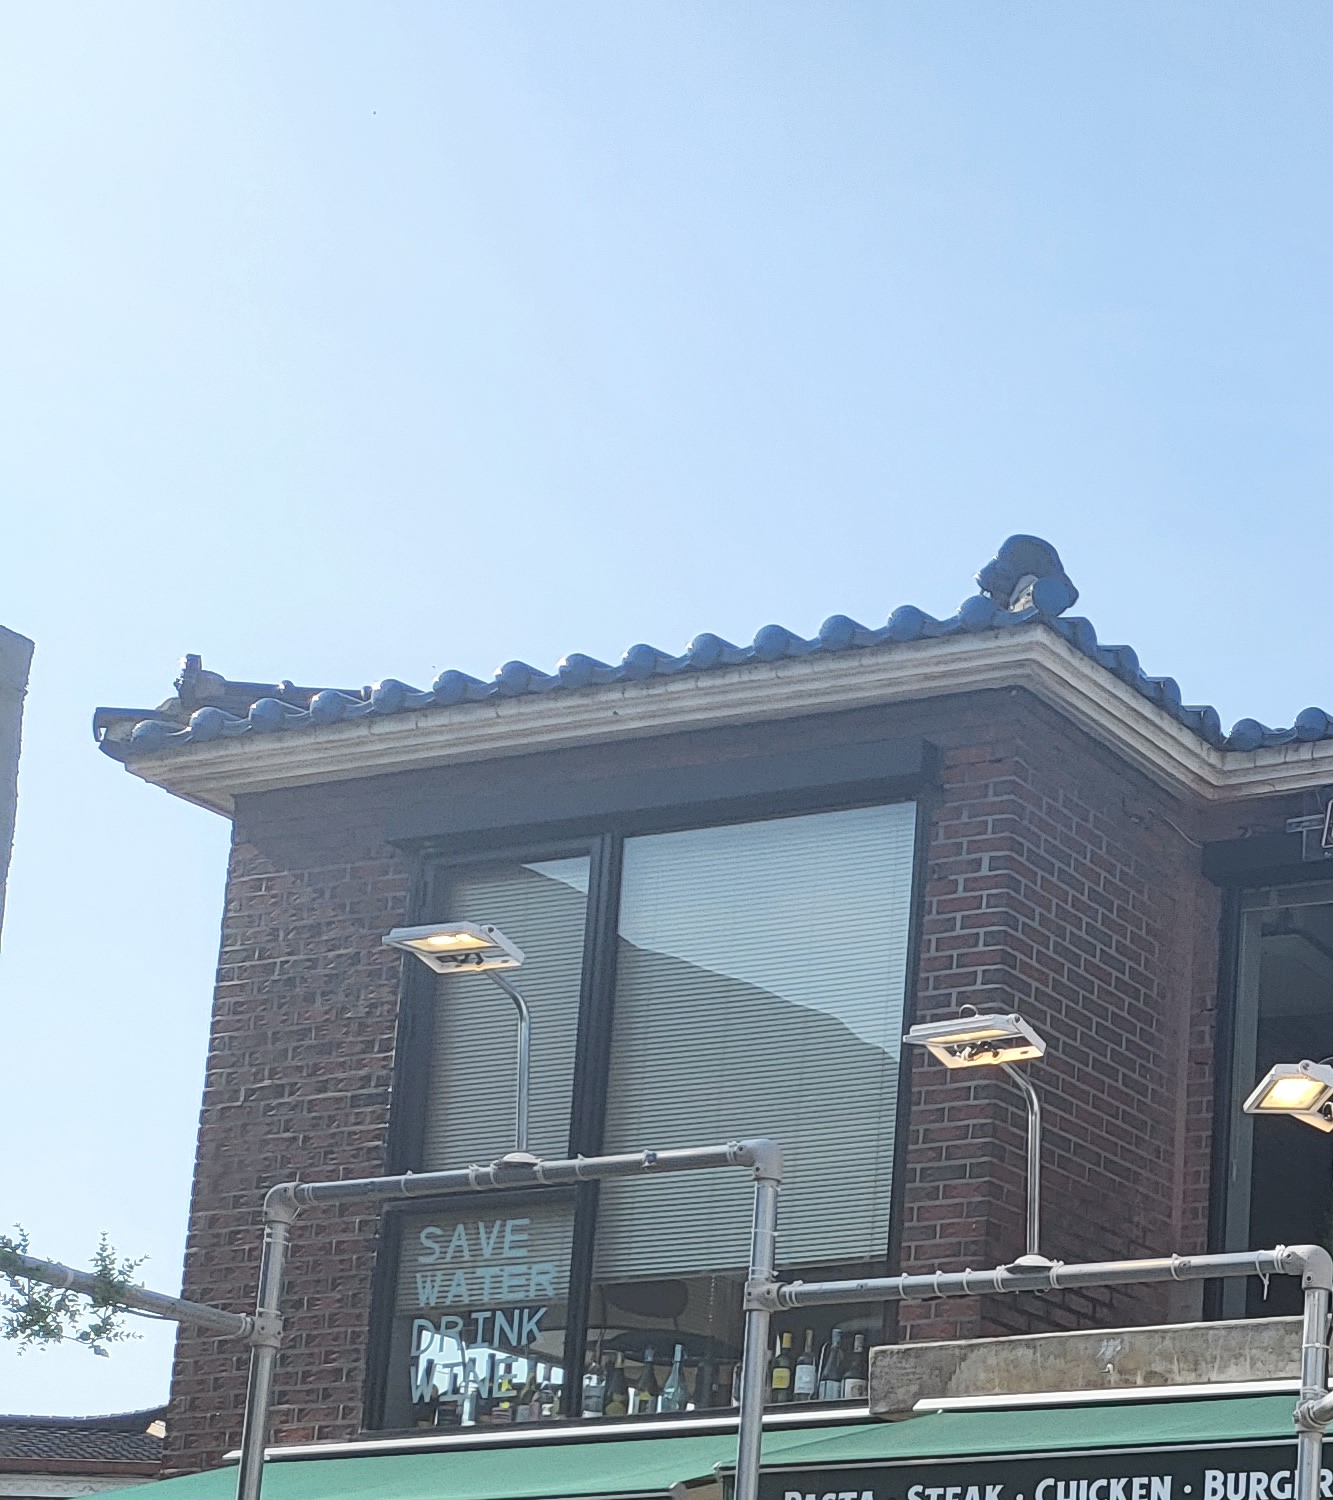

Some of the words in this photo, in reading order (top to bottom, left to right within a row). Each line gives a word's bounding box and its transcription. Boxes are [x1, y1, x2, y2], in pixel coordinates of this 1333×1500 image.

[417, 1218, 531, 1264] SAVE
[416, 1263, 557, 1308] WATER
[410, 1306, 549, 1357] DRINK
